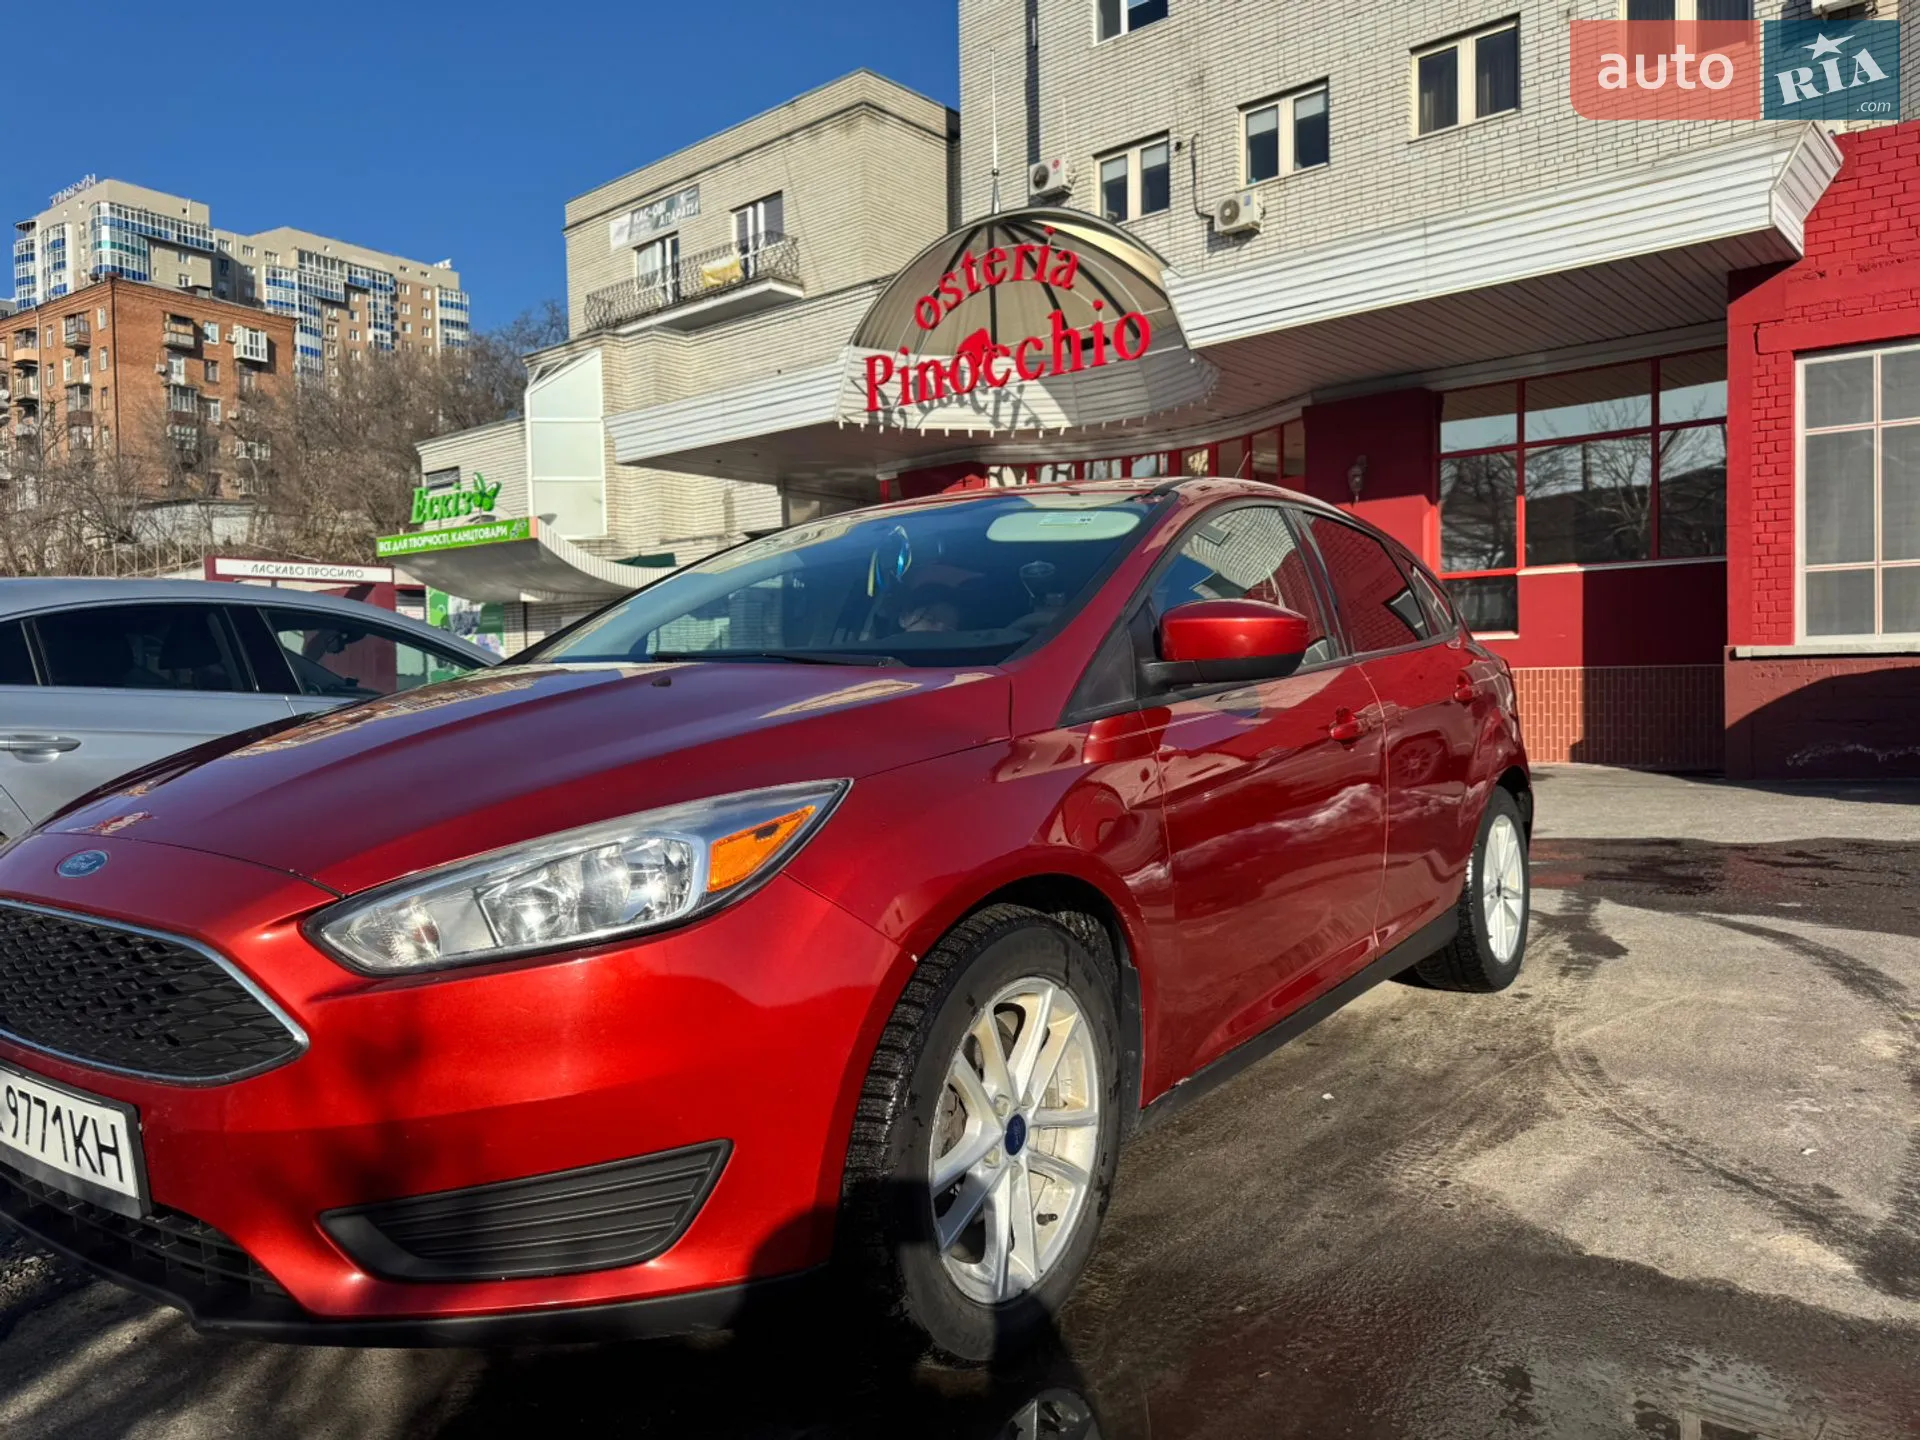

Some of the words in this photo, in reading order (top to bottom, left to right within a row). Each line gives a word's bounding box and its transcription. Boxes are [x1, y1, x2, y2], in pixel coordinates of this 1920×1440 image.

[914, 226, 1079, 330] osteria
[864, 299, 1151, 412] Pinocchio
[410, 482, 473, 524] Ескіз
[378, 541, 392, 552] ВСЕ
[392, 539, 407, 552] ДЛЯ
[451, 525, 508, 544] КАНЦТОВАРИ
[251, 563, 305, 576] ЛАСКАВО
[307, 565, 364, 579] ПРОСИМО
